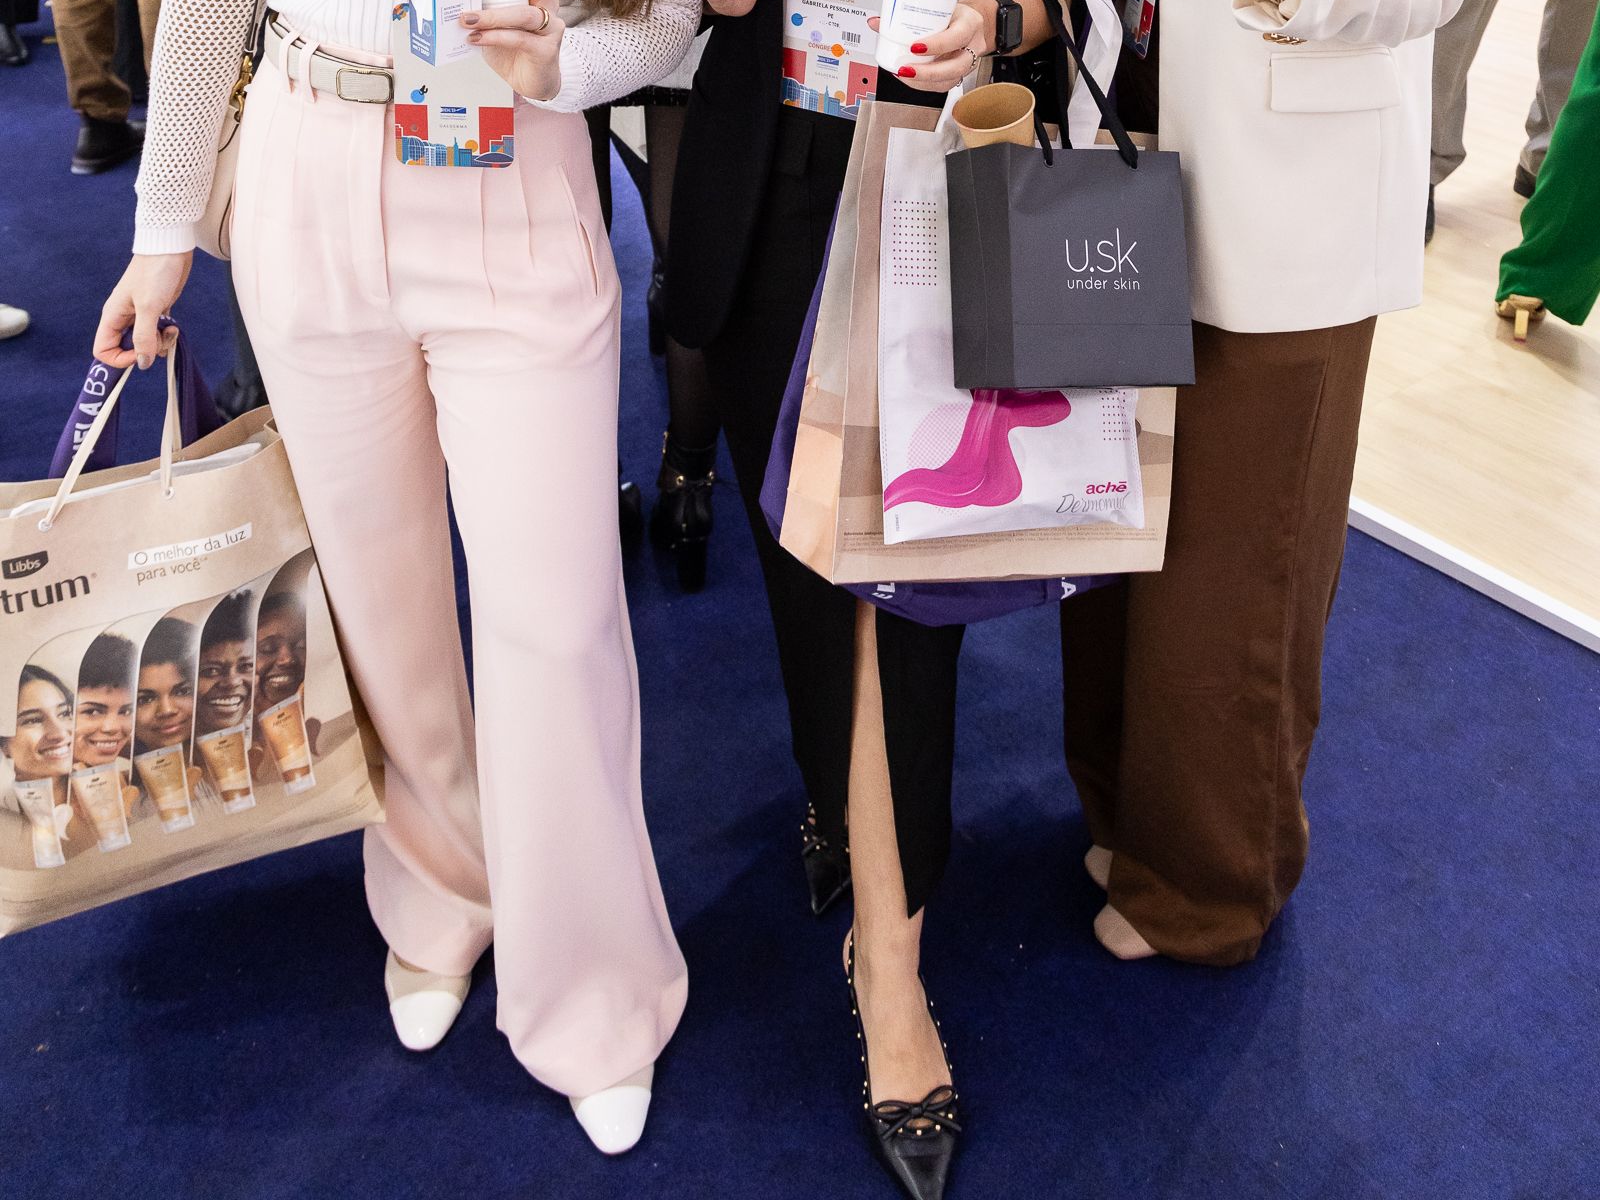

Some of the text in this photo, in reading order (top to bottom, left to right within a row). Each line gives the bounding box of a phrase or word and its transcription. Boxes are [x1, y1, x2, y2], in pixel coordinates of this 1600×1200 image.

[801, 0, 867, 18] GABRIELA PESSOA MOTA
[1067, 276, 1140, 290] under skin
[134, 529, 247, 565] O melhor da luz
[9, 557, 41, 574] Libbs
[137, 557, 201, 586] para você
